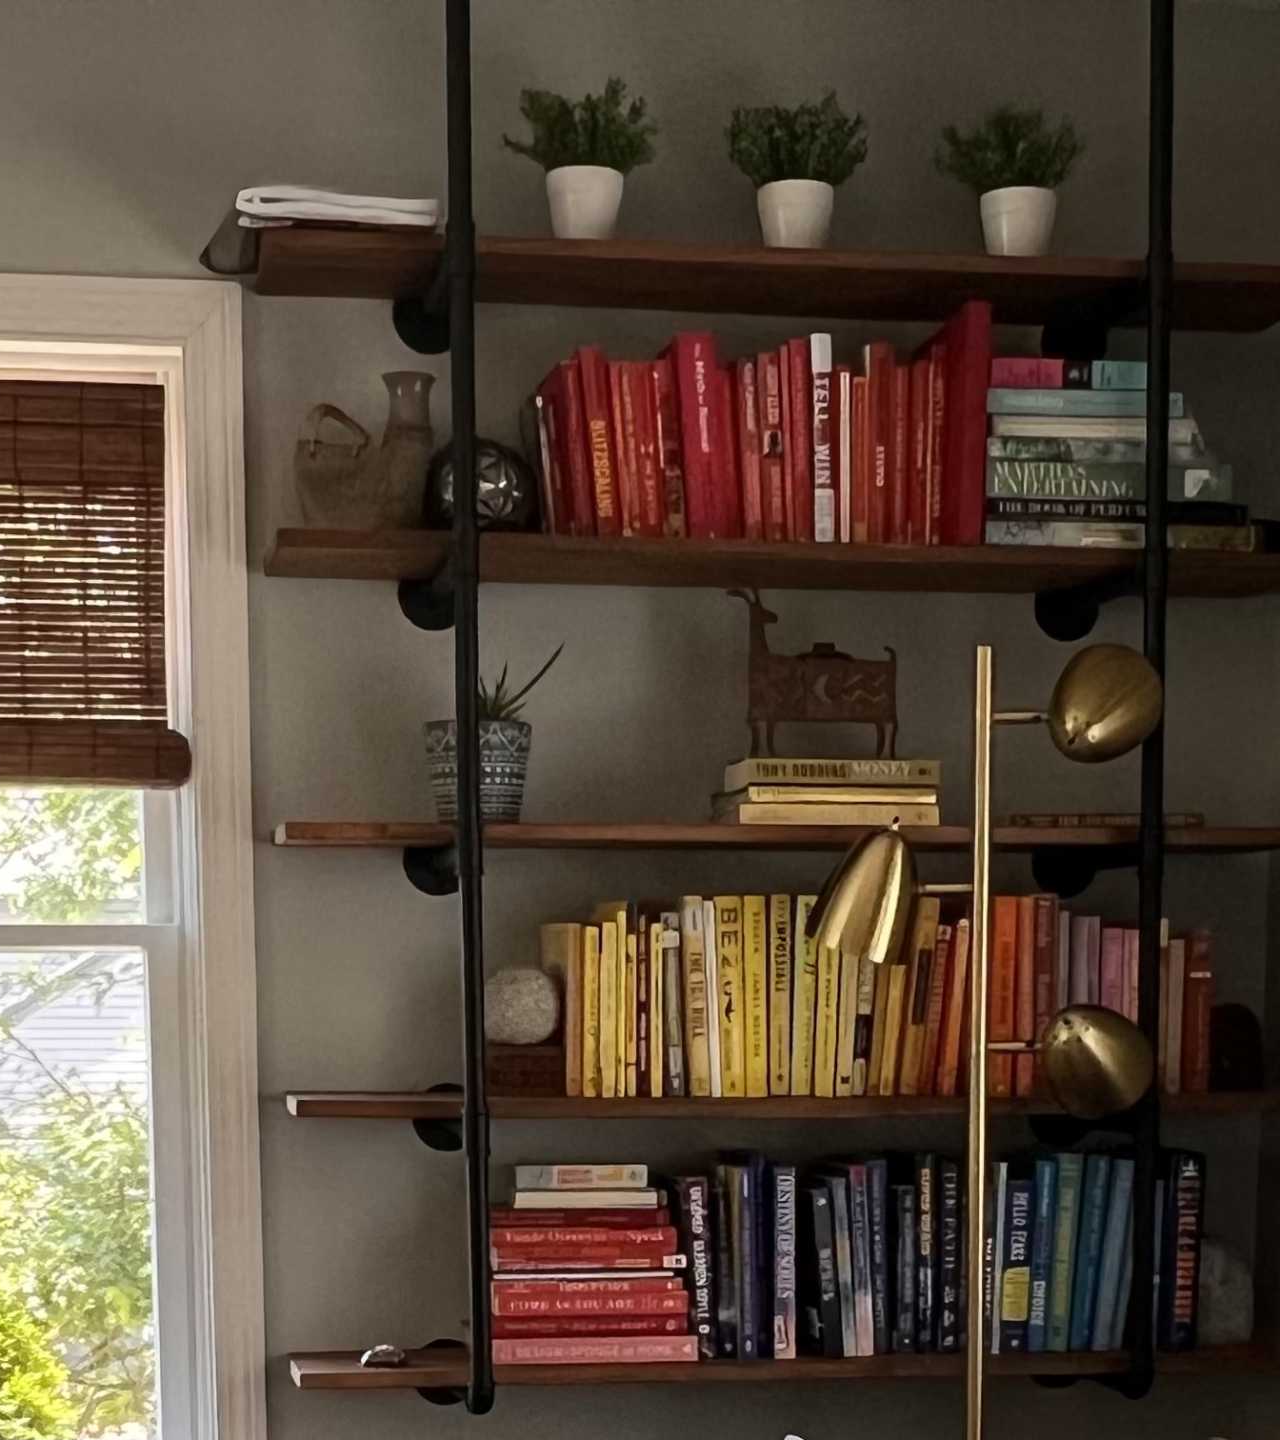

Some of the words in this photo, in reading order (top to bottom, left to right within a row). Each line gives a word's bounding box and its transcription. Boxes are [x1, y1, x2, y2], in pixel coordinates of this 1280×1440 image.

[589, 419, 614, 518] BLITZSCALING
[816, 443, 831, 485] WIN
[776, 1174, 795, 1235] DESTINY
[777, 1255, 795, 1300] SOULS
